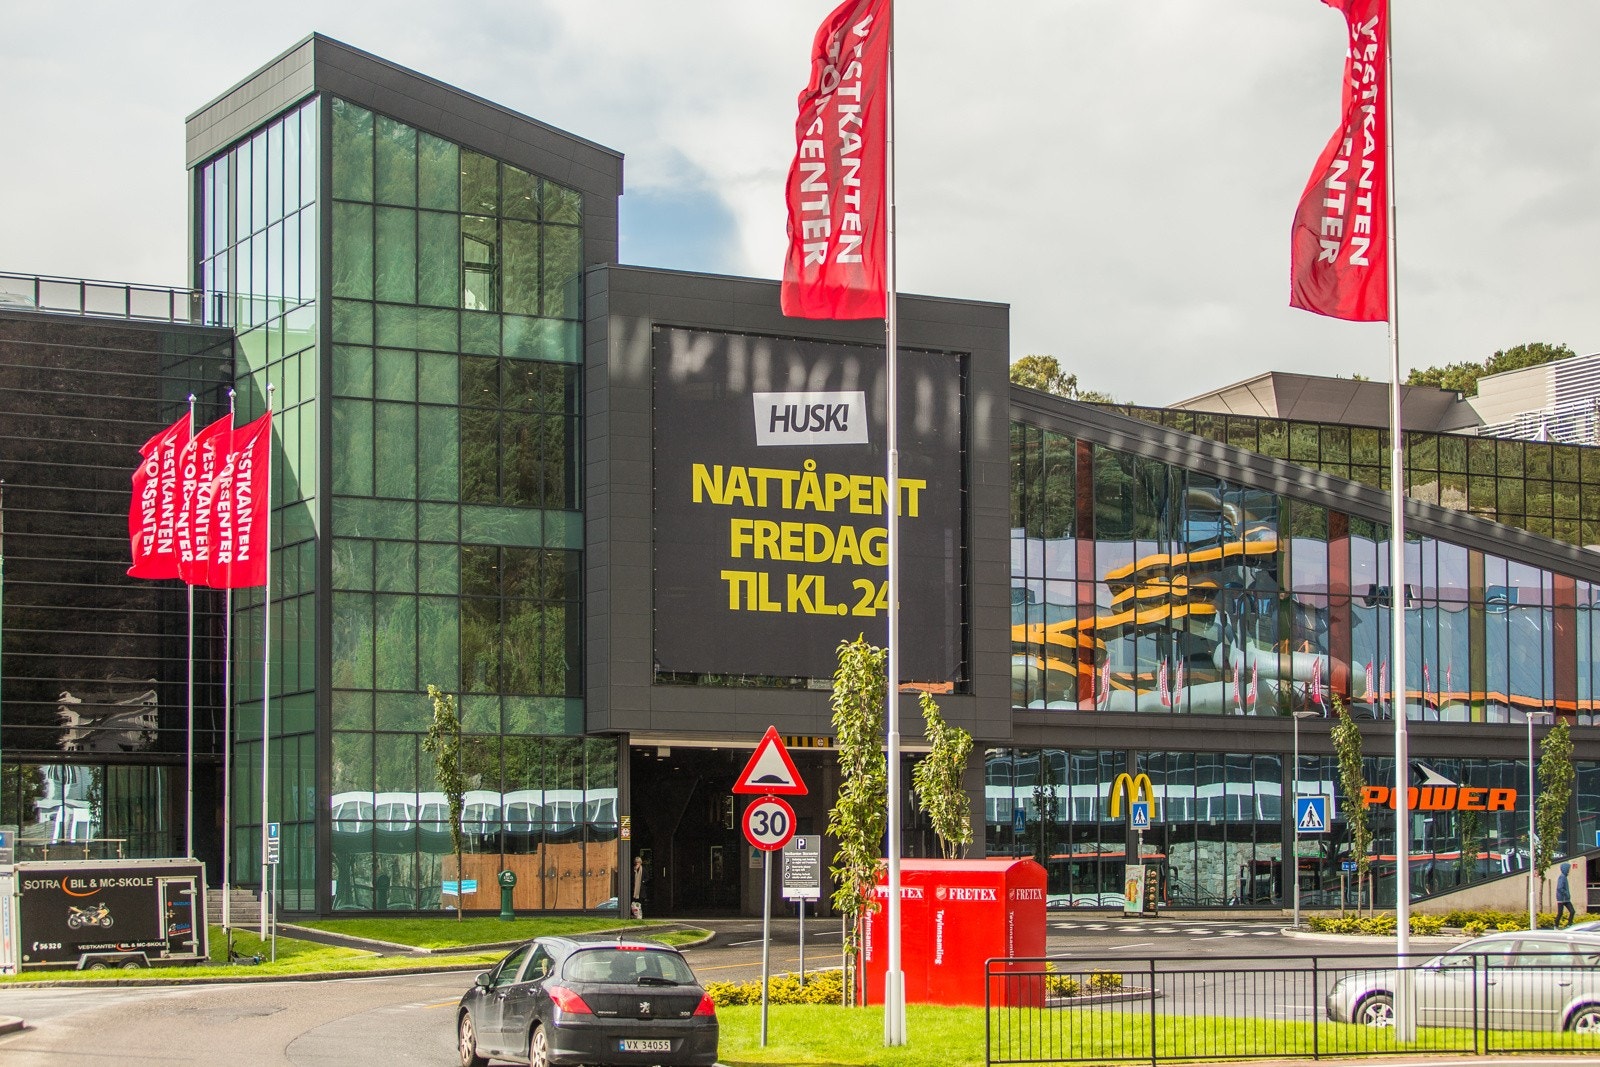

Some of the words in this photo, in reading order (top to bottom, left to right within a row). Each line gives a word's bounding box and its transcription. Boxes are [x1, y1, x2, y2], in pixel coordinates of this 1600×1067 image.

[799, 31, 841, 268] TOSENTER
[1349, 14, 1380, 267] VESTKANTEN
[769, 403, 850, 433] HUSK!
[141, 446, 159, 557] TORSENTER
[692, 459, 927, 518] NATTÅPENT
[730, 518, 889, 567] FREDAG
[721, 570, 782, 613] TIL
[787, 574, 848, 617] KL.
[852, 578, 900, 618] 24
[1361, 786, 1517, 811] POWER
[752, 810, 786, 837] 30
[798, 839, 805, 850] P
[24, 879, 61, 890] SOTRA
[70, 879, 88, 889] BIL
[89, 878, 97, 888] &
[100, 877, 154, 888] MC-SKOLE
[877, 886, 924, 899] FTEX
[949, 888, 997, 901] FRETEX
[1016, 888, 1043, 900] FRETEX
[626, 1041, 638, 1049] VX
[642, 1041, 669, 1049] 34055
